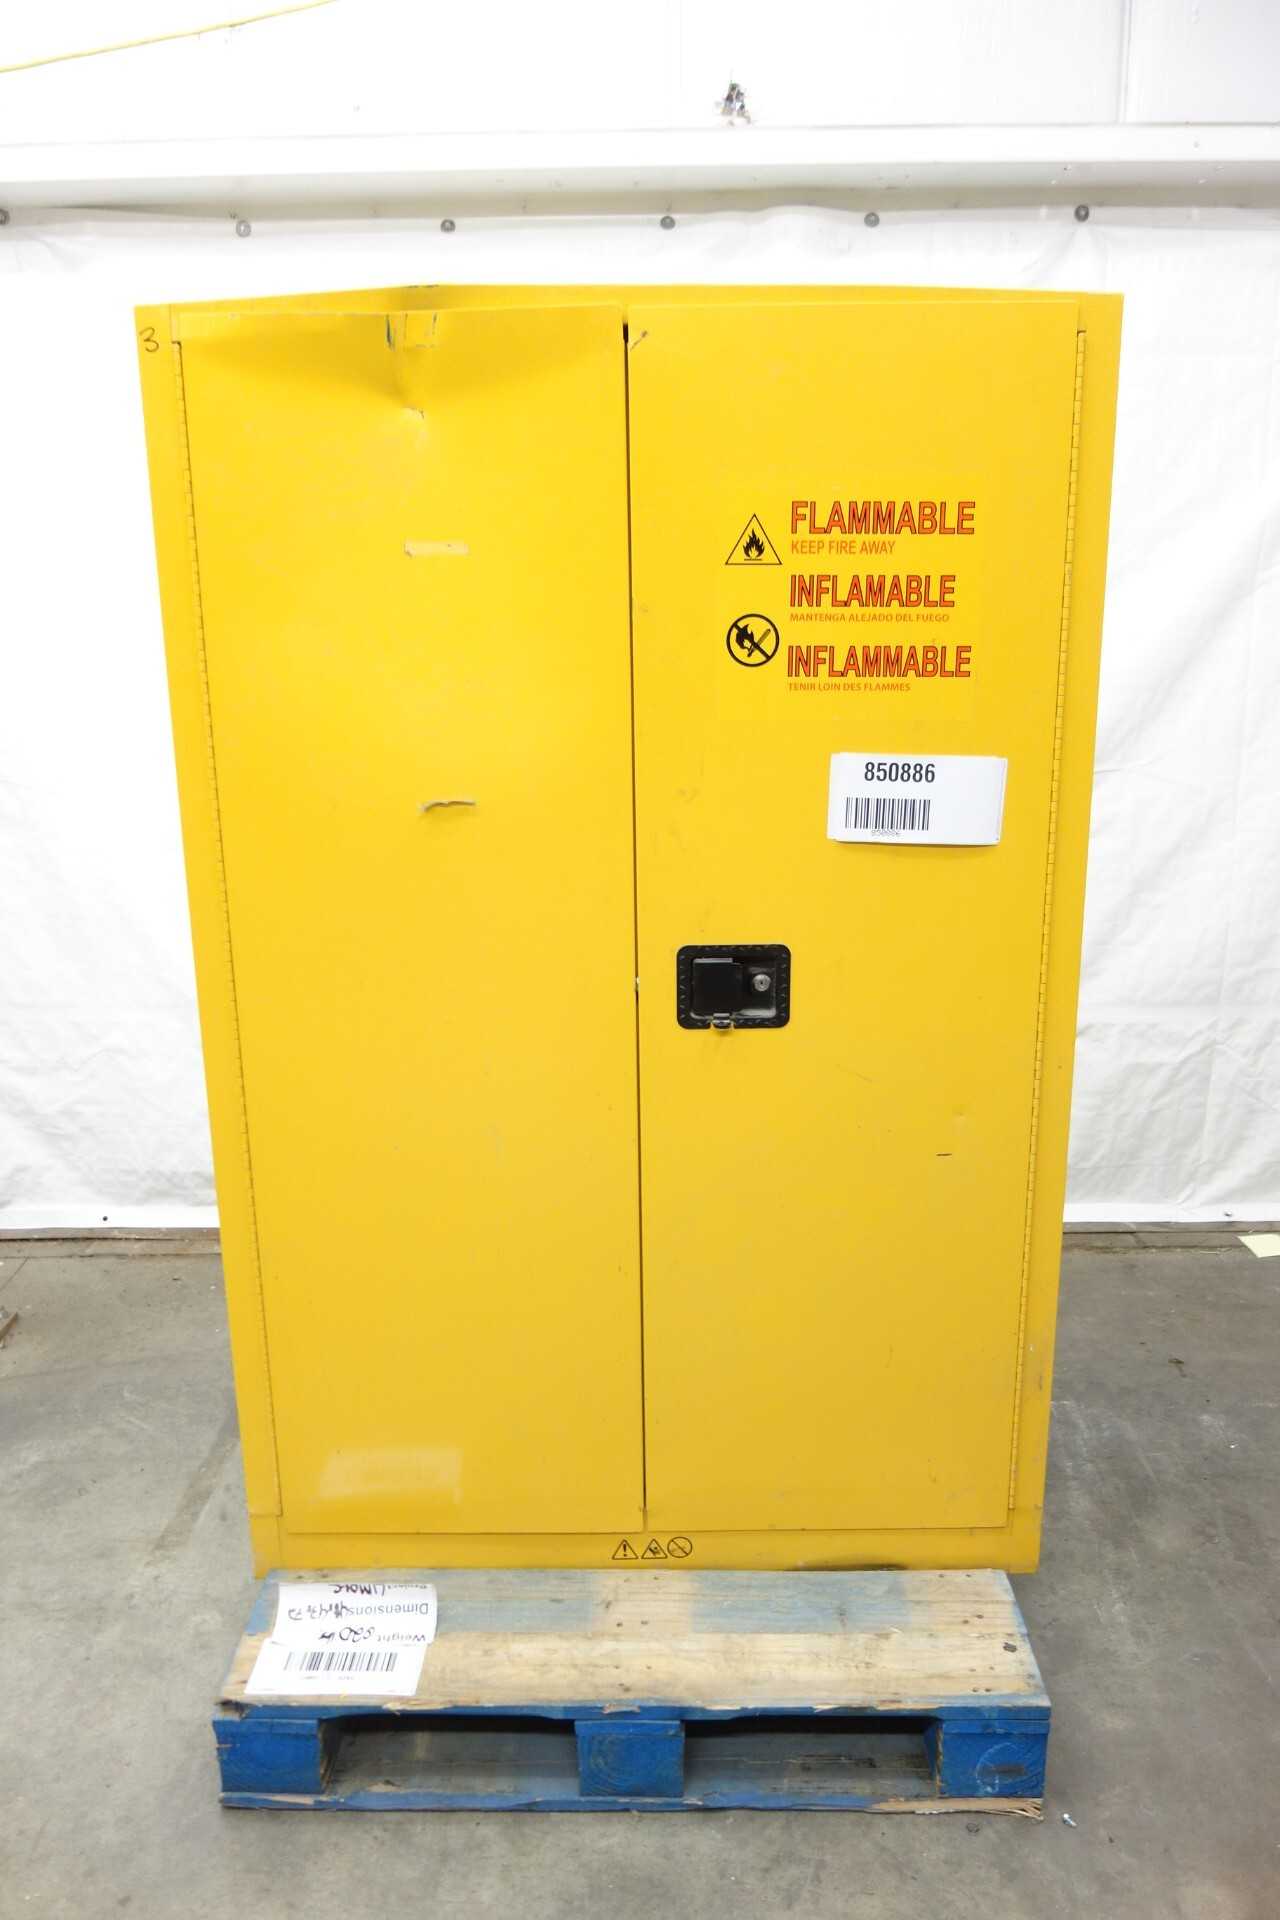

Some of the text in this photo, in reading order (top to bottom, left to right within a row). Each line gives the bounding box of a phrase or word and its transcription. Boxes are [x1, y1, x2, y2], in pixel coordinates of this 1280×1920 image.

[138, 326, 160, 353] 3
[790, 500, 976, 535] FLAMMABLE
[791, 540, 896, 555] KEEP FIRE AWAY
[789, 574, 957, 608] INFLAMABLE
[789, 613, 950, 623] MANTENGA ALEJADO DEL FUEGO
[787, 645, 972, 678] INFLAMMABLE
[788, 682, 912, 692] TENIR LOIN DES FLAMMES
[864, 761, 936, 784] 850886
[349, 1602, 429, 1616] Dimensions
[377, 1633, 427, 1643] Weight
